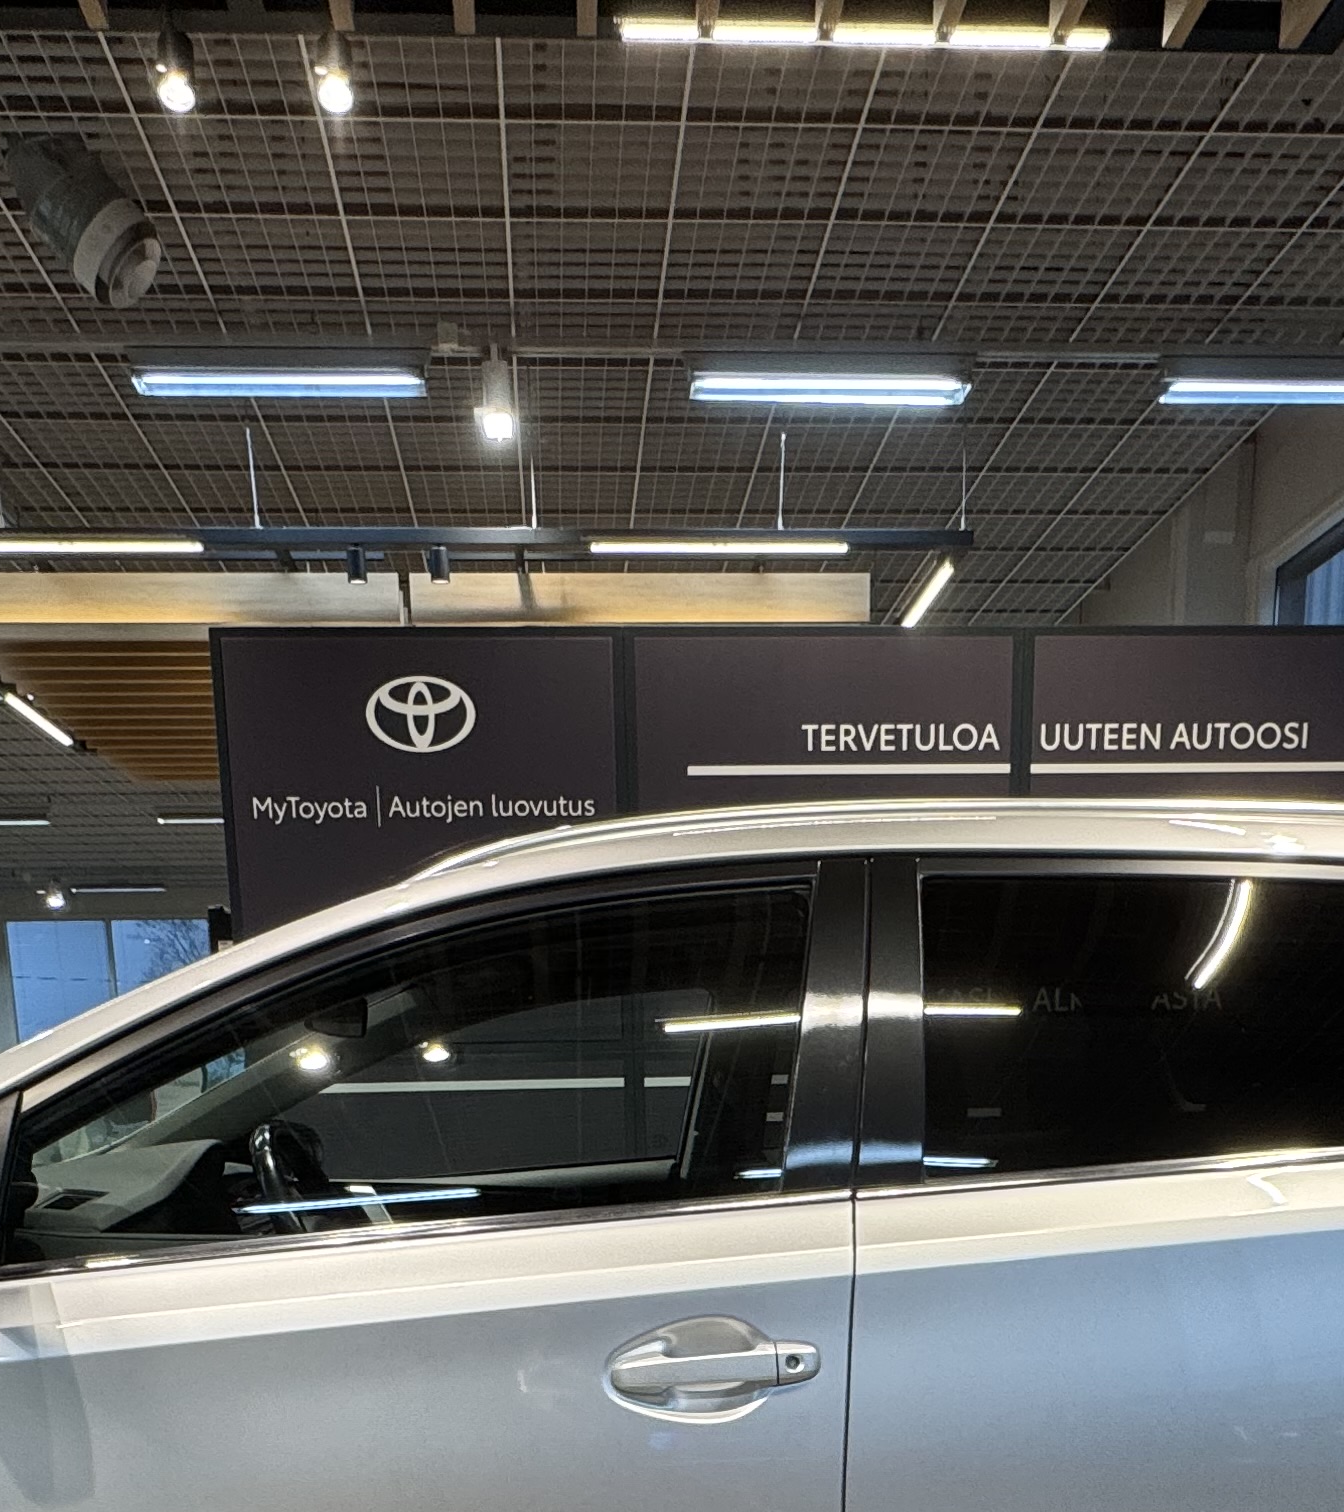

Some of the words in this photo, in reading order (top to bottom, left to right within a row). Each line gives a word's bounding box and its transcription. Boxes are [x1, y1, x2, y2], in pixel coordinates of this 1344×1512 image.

[801, 722, 1001, 752] TERVETULOA
[1039, 722, 1162, 752] UUTEEN
[1169, 721, 1309, 751] AUTOOSI
[252, 796, 367, 825] MyToyota
[388, 794, 484, 824] Autojen
[491, 793, 596, 818] luovutus
